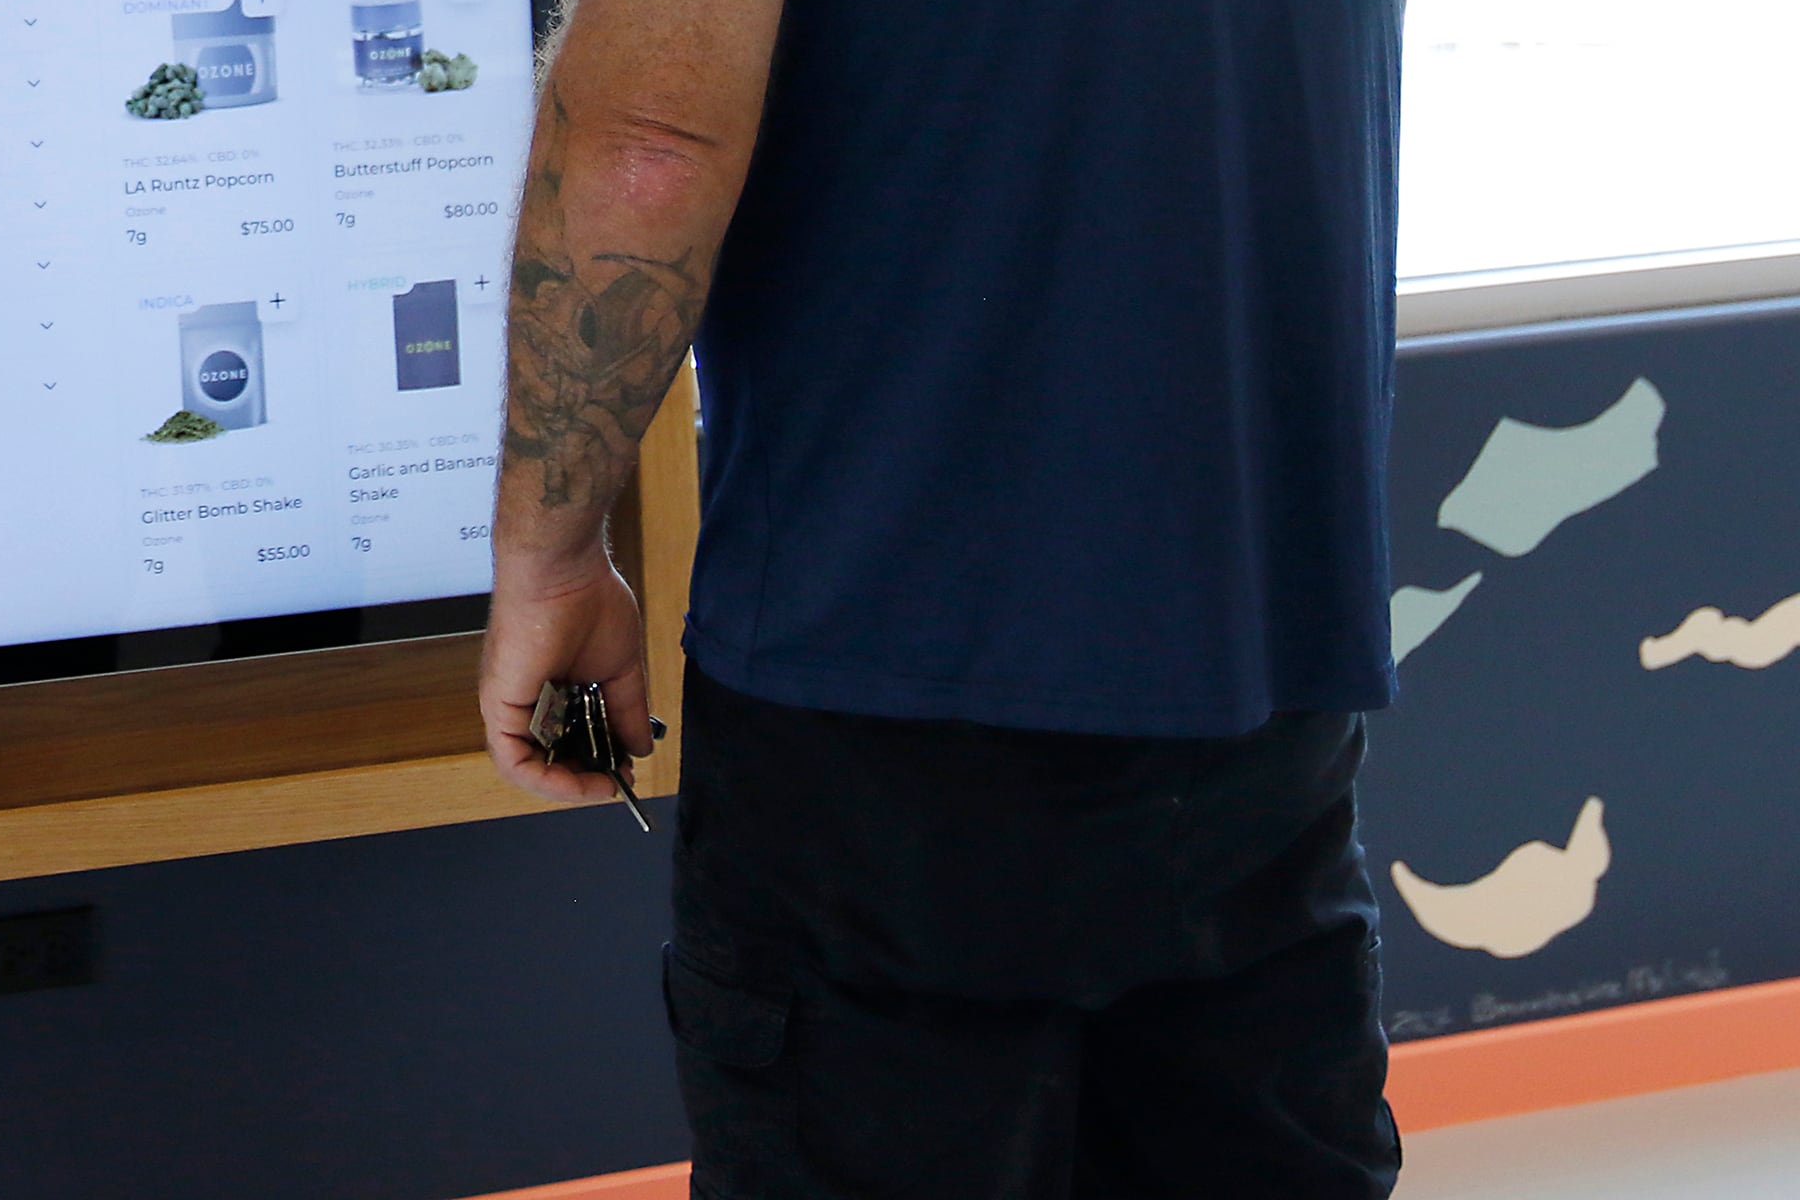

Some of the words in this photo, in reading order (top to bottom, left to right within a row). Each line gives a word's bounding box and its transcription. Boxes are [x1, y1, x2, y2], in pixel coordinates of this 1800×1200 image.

[370, 47, 412, 61] OZONE
[199, 63, 254, 80] OZONE
[334, 158, 422, 178] Butterstuff
[427, 154, 495, 174] Popcorn
[125, 180, 146, 195] LA
[152, 175, 200, 193] Runtz
[205, 171, 275, 191] Popcorn
[334, 188, 375, 201] Ozone
[125, 204, 167, 218] Ozone
[444, 201, 499, 219] $80.00
[240, 219, 295, 236] $75.00
[336, 212, 356, 228] 7g
[126, 229, 147, 246] 7g
[348, 276, 406, 291] HYBRID
[139, 296, 194, 311] INDICA
[405, 340, 452, 355] OZONE
[200, 368, 248, 384] OZONE
[349, 464, 395, 481] Garlic
[400, 461, 431, 475] and
[435, 455, 495, 472] Banana
[350, 486, 399, 504] Shake
[142, 507, 193, 525] Glitter
[198, 504, 248, 520] Bomb
[253, 497, 303, 515] Shake
[351, 512, 390, 525] Ozone
[143, 535, 184, 547] Ozone
[352, 536, 372, 552] 7g
[257, 544, 311, 562] $55.00
[144, 558, 164, 574] 7g
